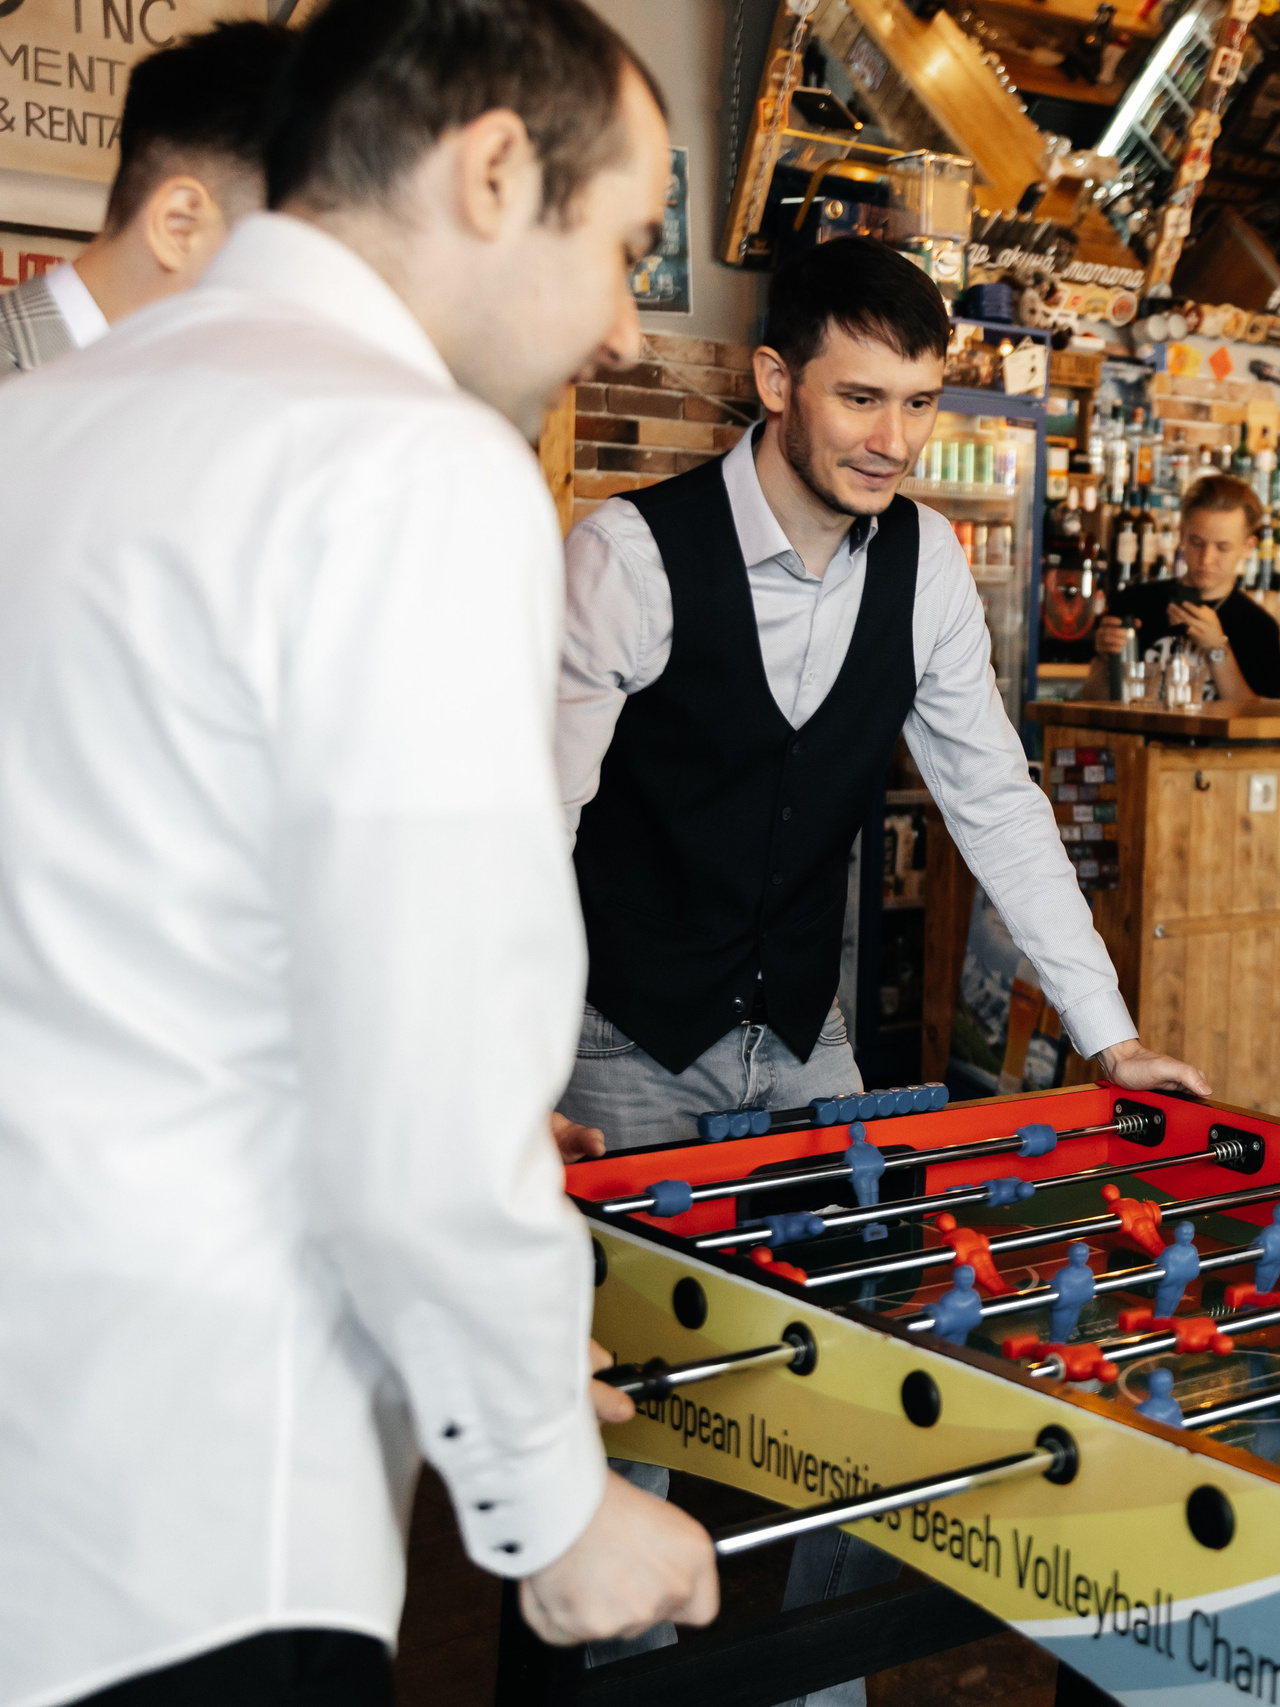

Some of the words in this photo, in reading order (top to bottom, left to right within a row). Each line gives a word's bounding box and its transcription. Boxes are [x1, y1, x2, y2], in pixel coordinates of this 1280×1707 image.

[0, 251, 66, 287] LIT
[636, 1393, 741, 1459] uropean
[912, 1500, 1002, 1579] Beach
[1012, 1527, 1177, 1662] Volleyball
